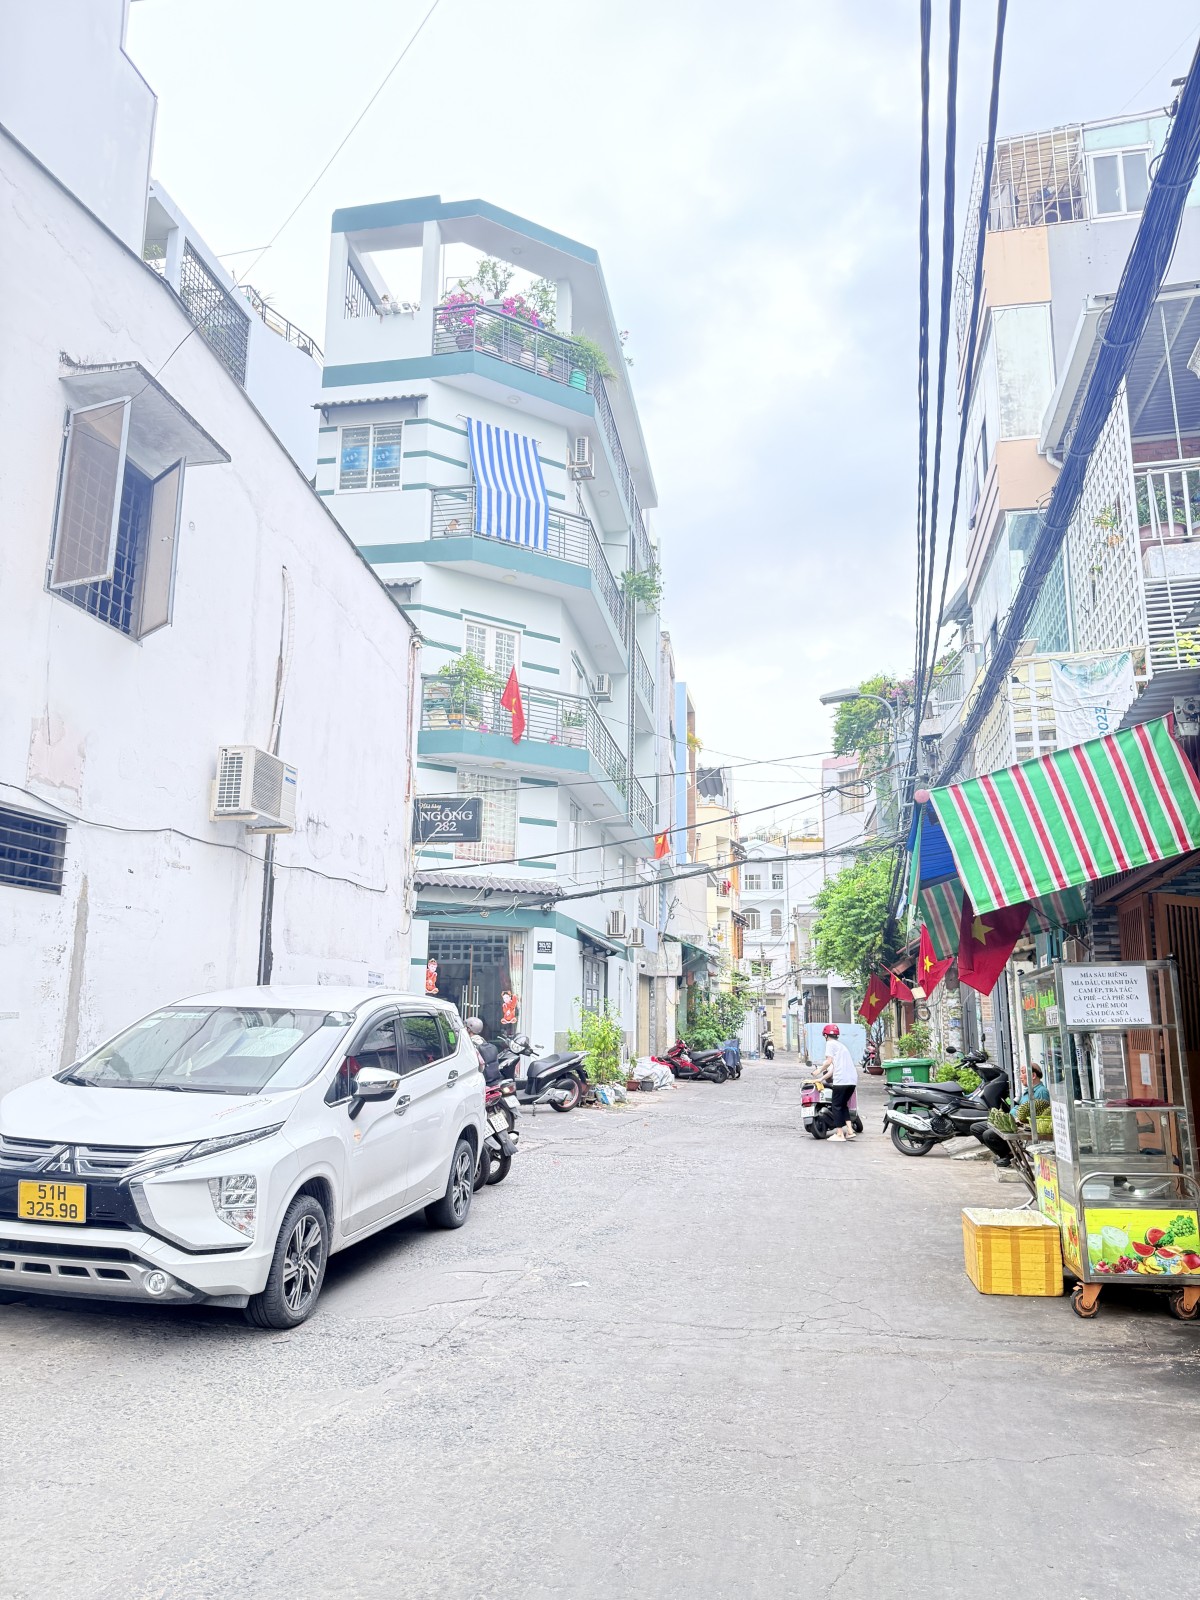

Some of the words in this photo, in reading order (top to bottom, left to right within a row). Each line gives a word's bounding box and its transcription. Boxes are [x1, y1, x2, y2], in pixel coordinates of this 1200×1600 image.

[420, 808, 473, 821] NGỖNG
[435, 822, 457, 831] 282
[38, 1184, 66, 1200] 51H
[26, 1201, 78, 1219] 325.98
